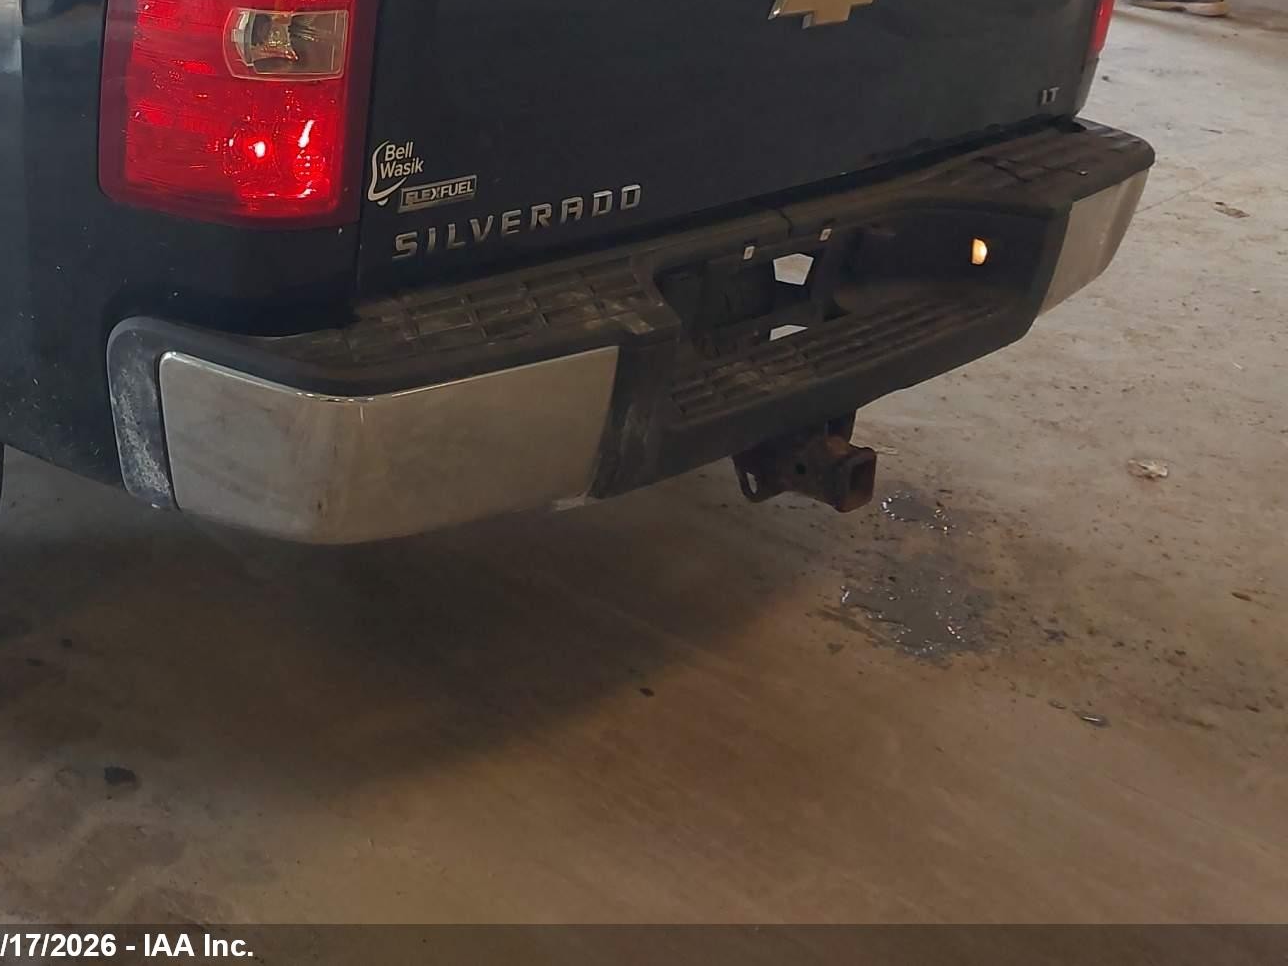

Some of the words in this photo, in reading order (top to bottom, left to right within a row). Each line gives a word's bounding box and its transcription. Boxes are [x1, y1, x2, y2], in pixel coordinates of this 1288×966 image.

[384, 141, 414, 162] Bell
[379, 156, 425, 179] Wasik
[392, 184, 641, 259] SILVERADO
